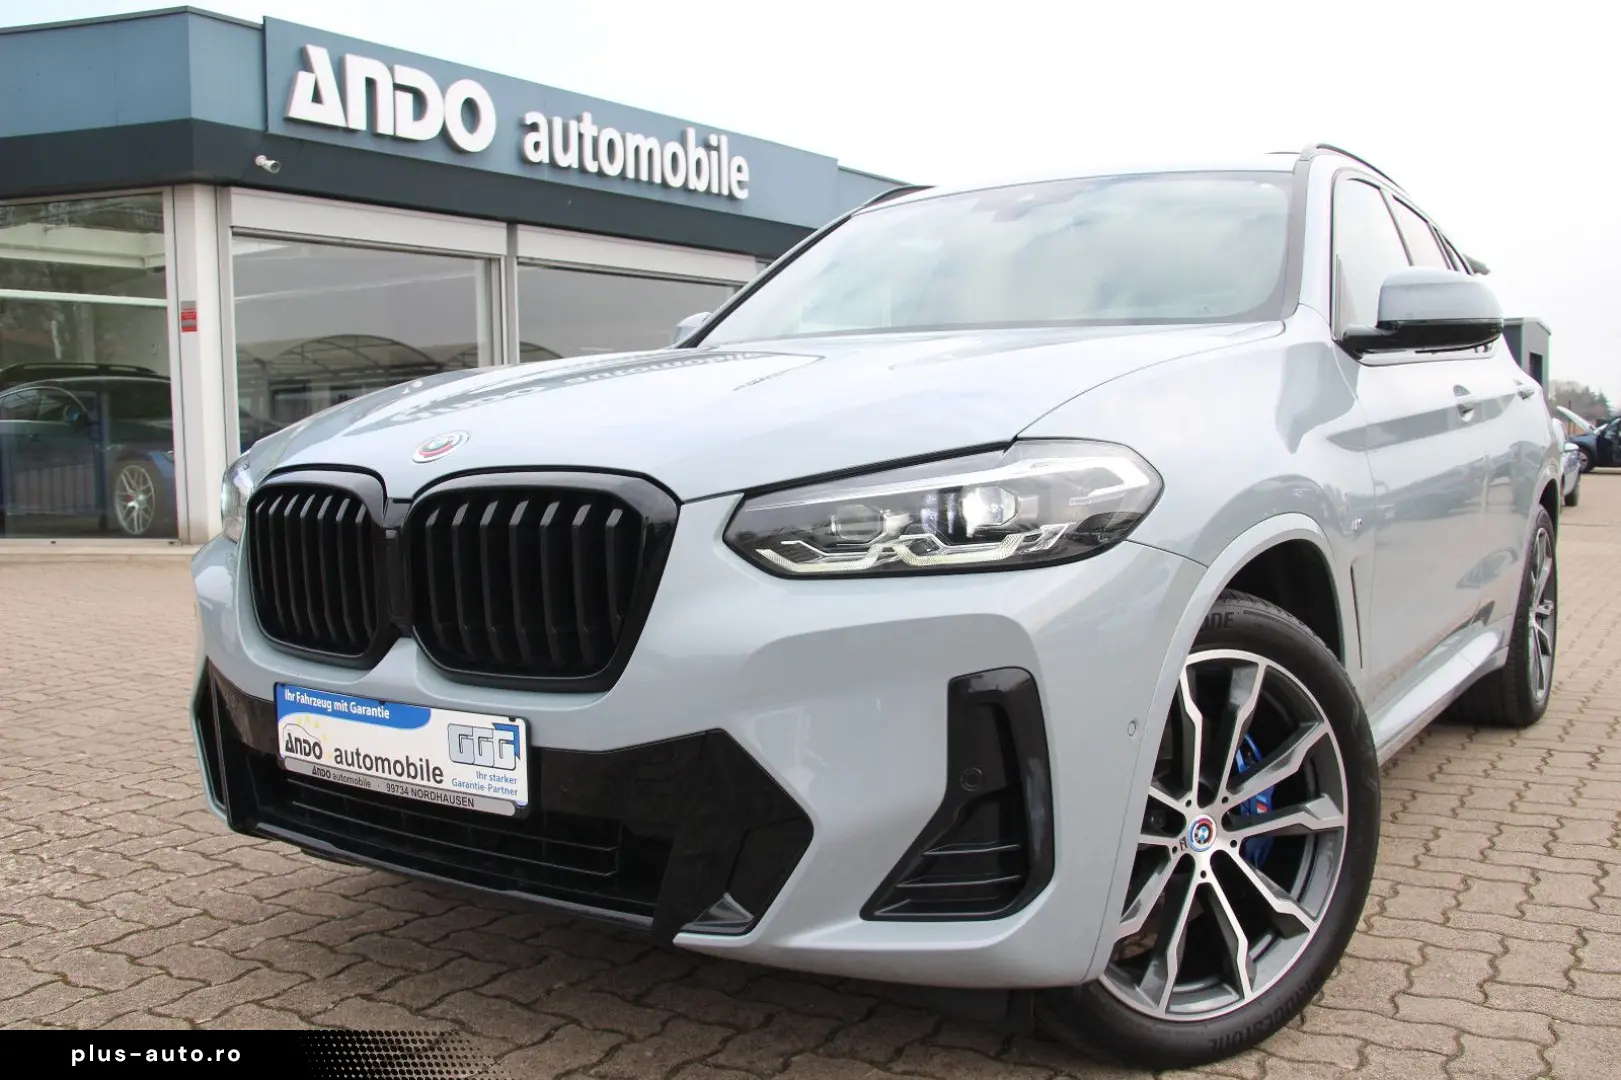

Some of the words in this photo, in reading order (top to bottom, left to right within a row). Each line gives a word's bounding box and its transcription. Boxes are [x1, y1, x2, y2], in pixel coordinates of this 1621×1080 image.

[520, 111, 750, 199] automobile
[284, 688, 295, 701] Ihr
[296, 690, 332, 711] Fahrzeug
[334, 700, 348, 711] mit
[350, 702, 390, 719] Garantie
[334, 747, 444, 784] automobile
[476, 770, 487, 780] Ihr
[489, 774, 518, 784] starker
[332, 771, 371, 788] automobile
[386, 782, 409, 796] 99734
[410, 787, 475, 808] NORDHAUSEN
